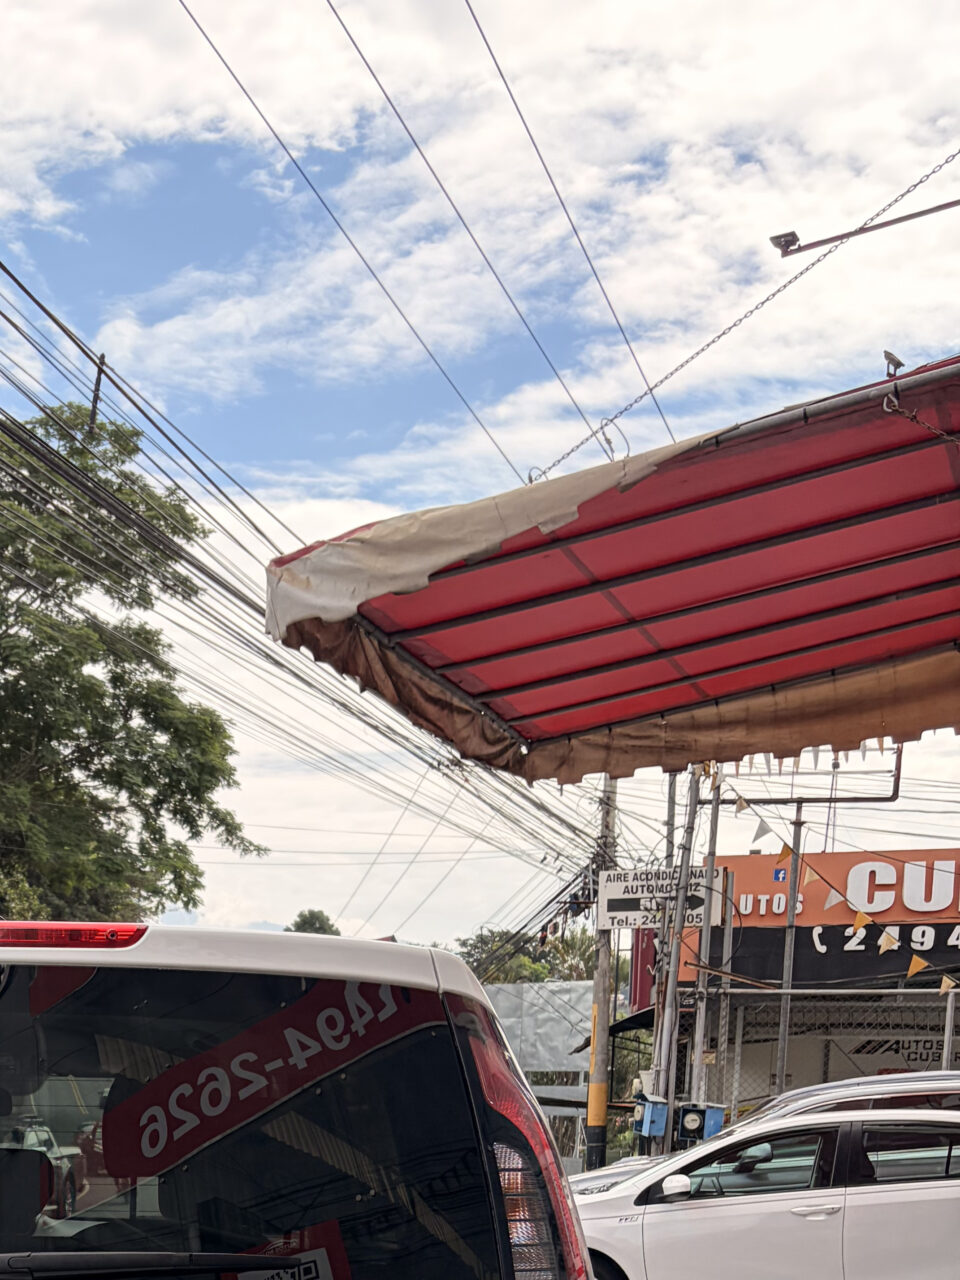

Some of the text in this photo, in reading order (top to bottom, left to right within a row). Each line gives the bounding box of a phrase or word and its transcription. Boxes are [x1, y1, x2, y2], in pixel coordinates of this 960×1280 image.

[605, 873, 630, 883] AIRE
[847, 860, 960, 913] CU
[732, 893, 804, 916] UTOS
[881, 1039, 945, 1054] AUTOS
[907, 1051, 960, 1061] CUBR
